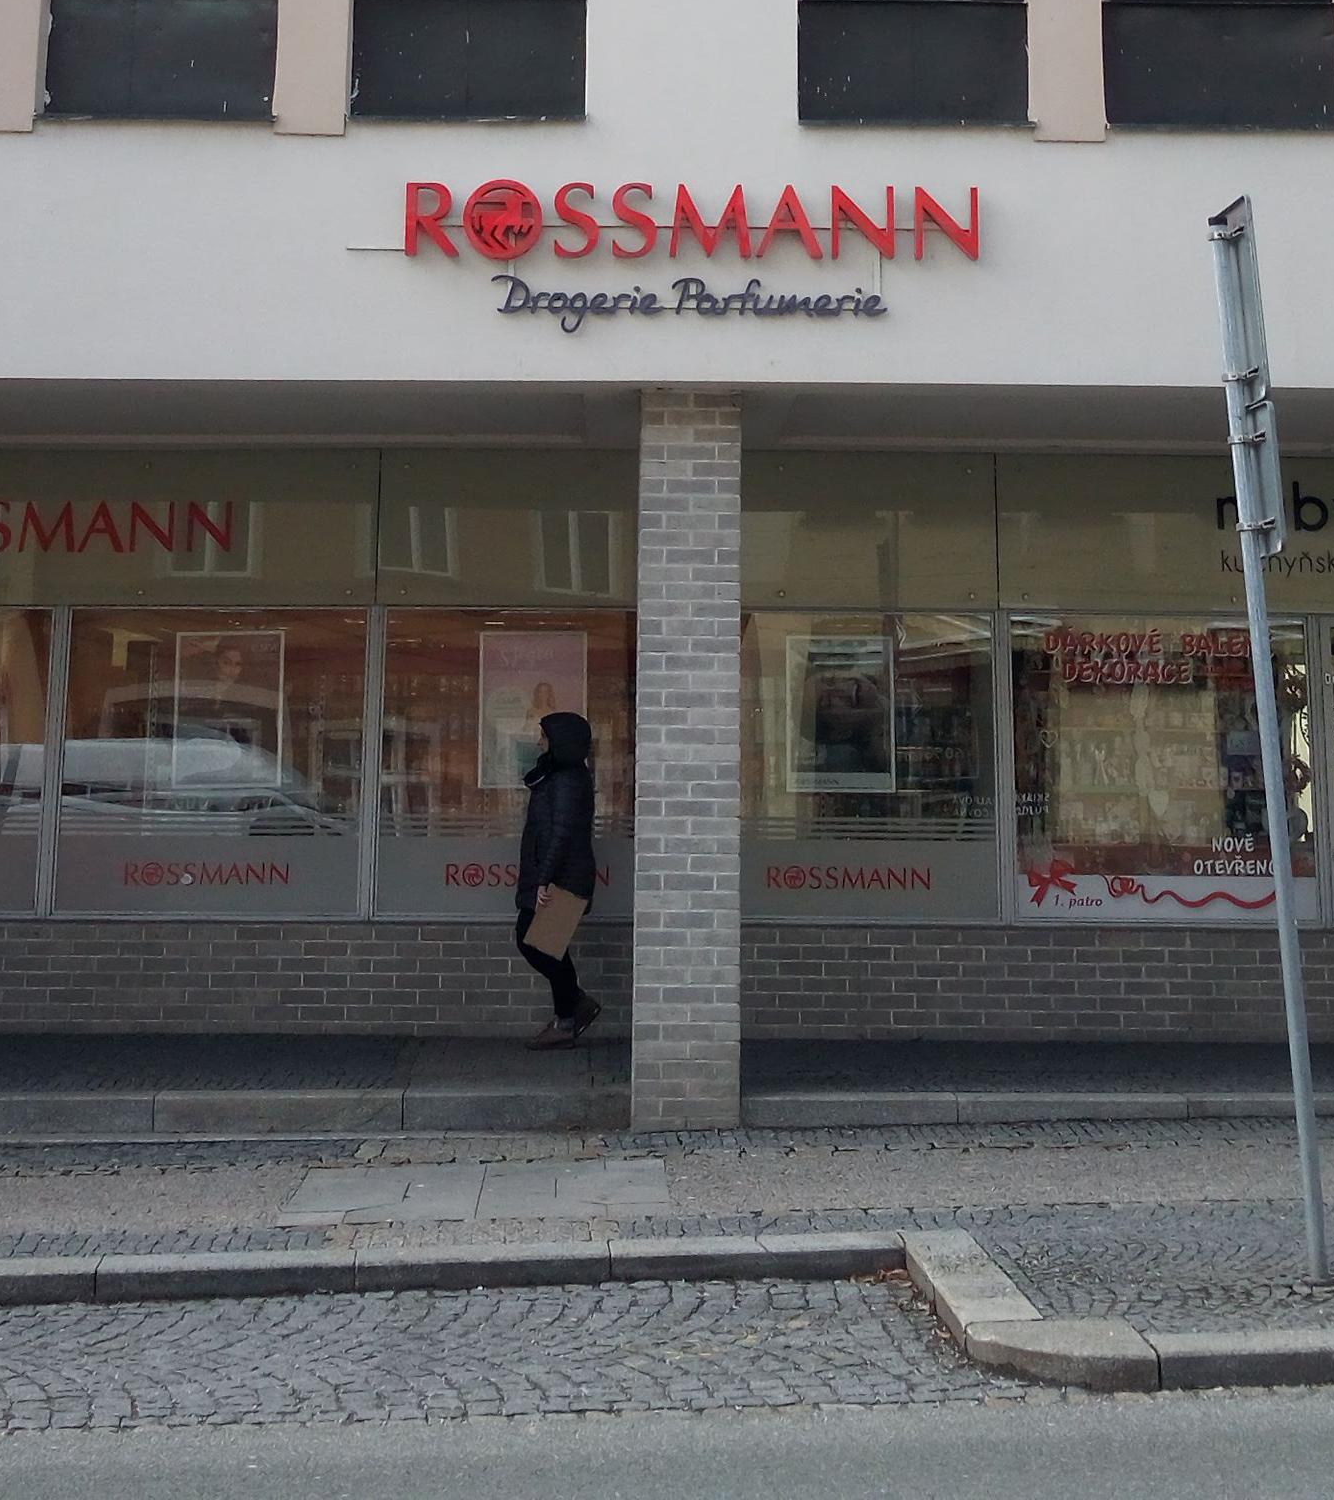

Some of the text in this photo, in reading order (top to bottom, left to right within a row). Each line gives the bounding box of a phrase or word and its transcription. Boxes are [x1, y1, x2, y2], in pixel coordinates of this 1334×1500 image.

[404, 179, 979, 260] ROSSMANN
[490, 274, 887, 333] Drogerie Parfumerie
[1043, 626, 1275, 658] DÁRKOVÉ BALE
[1063, 659, 1194, 685] DEKORACE
[124, 861, 289, 886] ROSSMANN
[445, 862, 609, 887] ROSSN
[766, 865, 931, 890] ROSSMANN
[1069, 896, 1103, 910] patro
